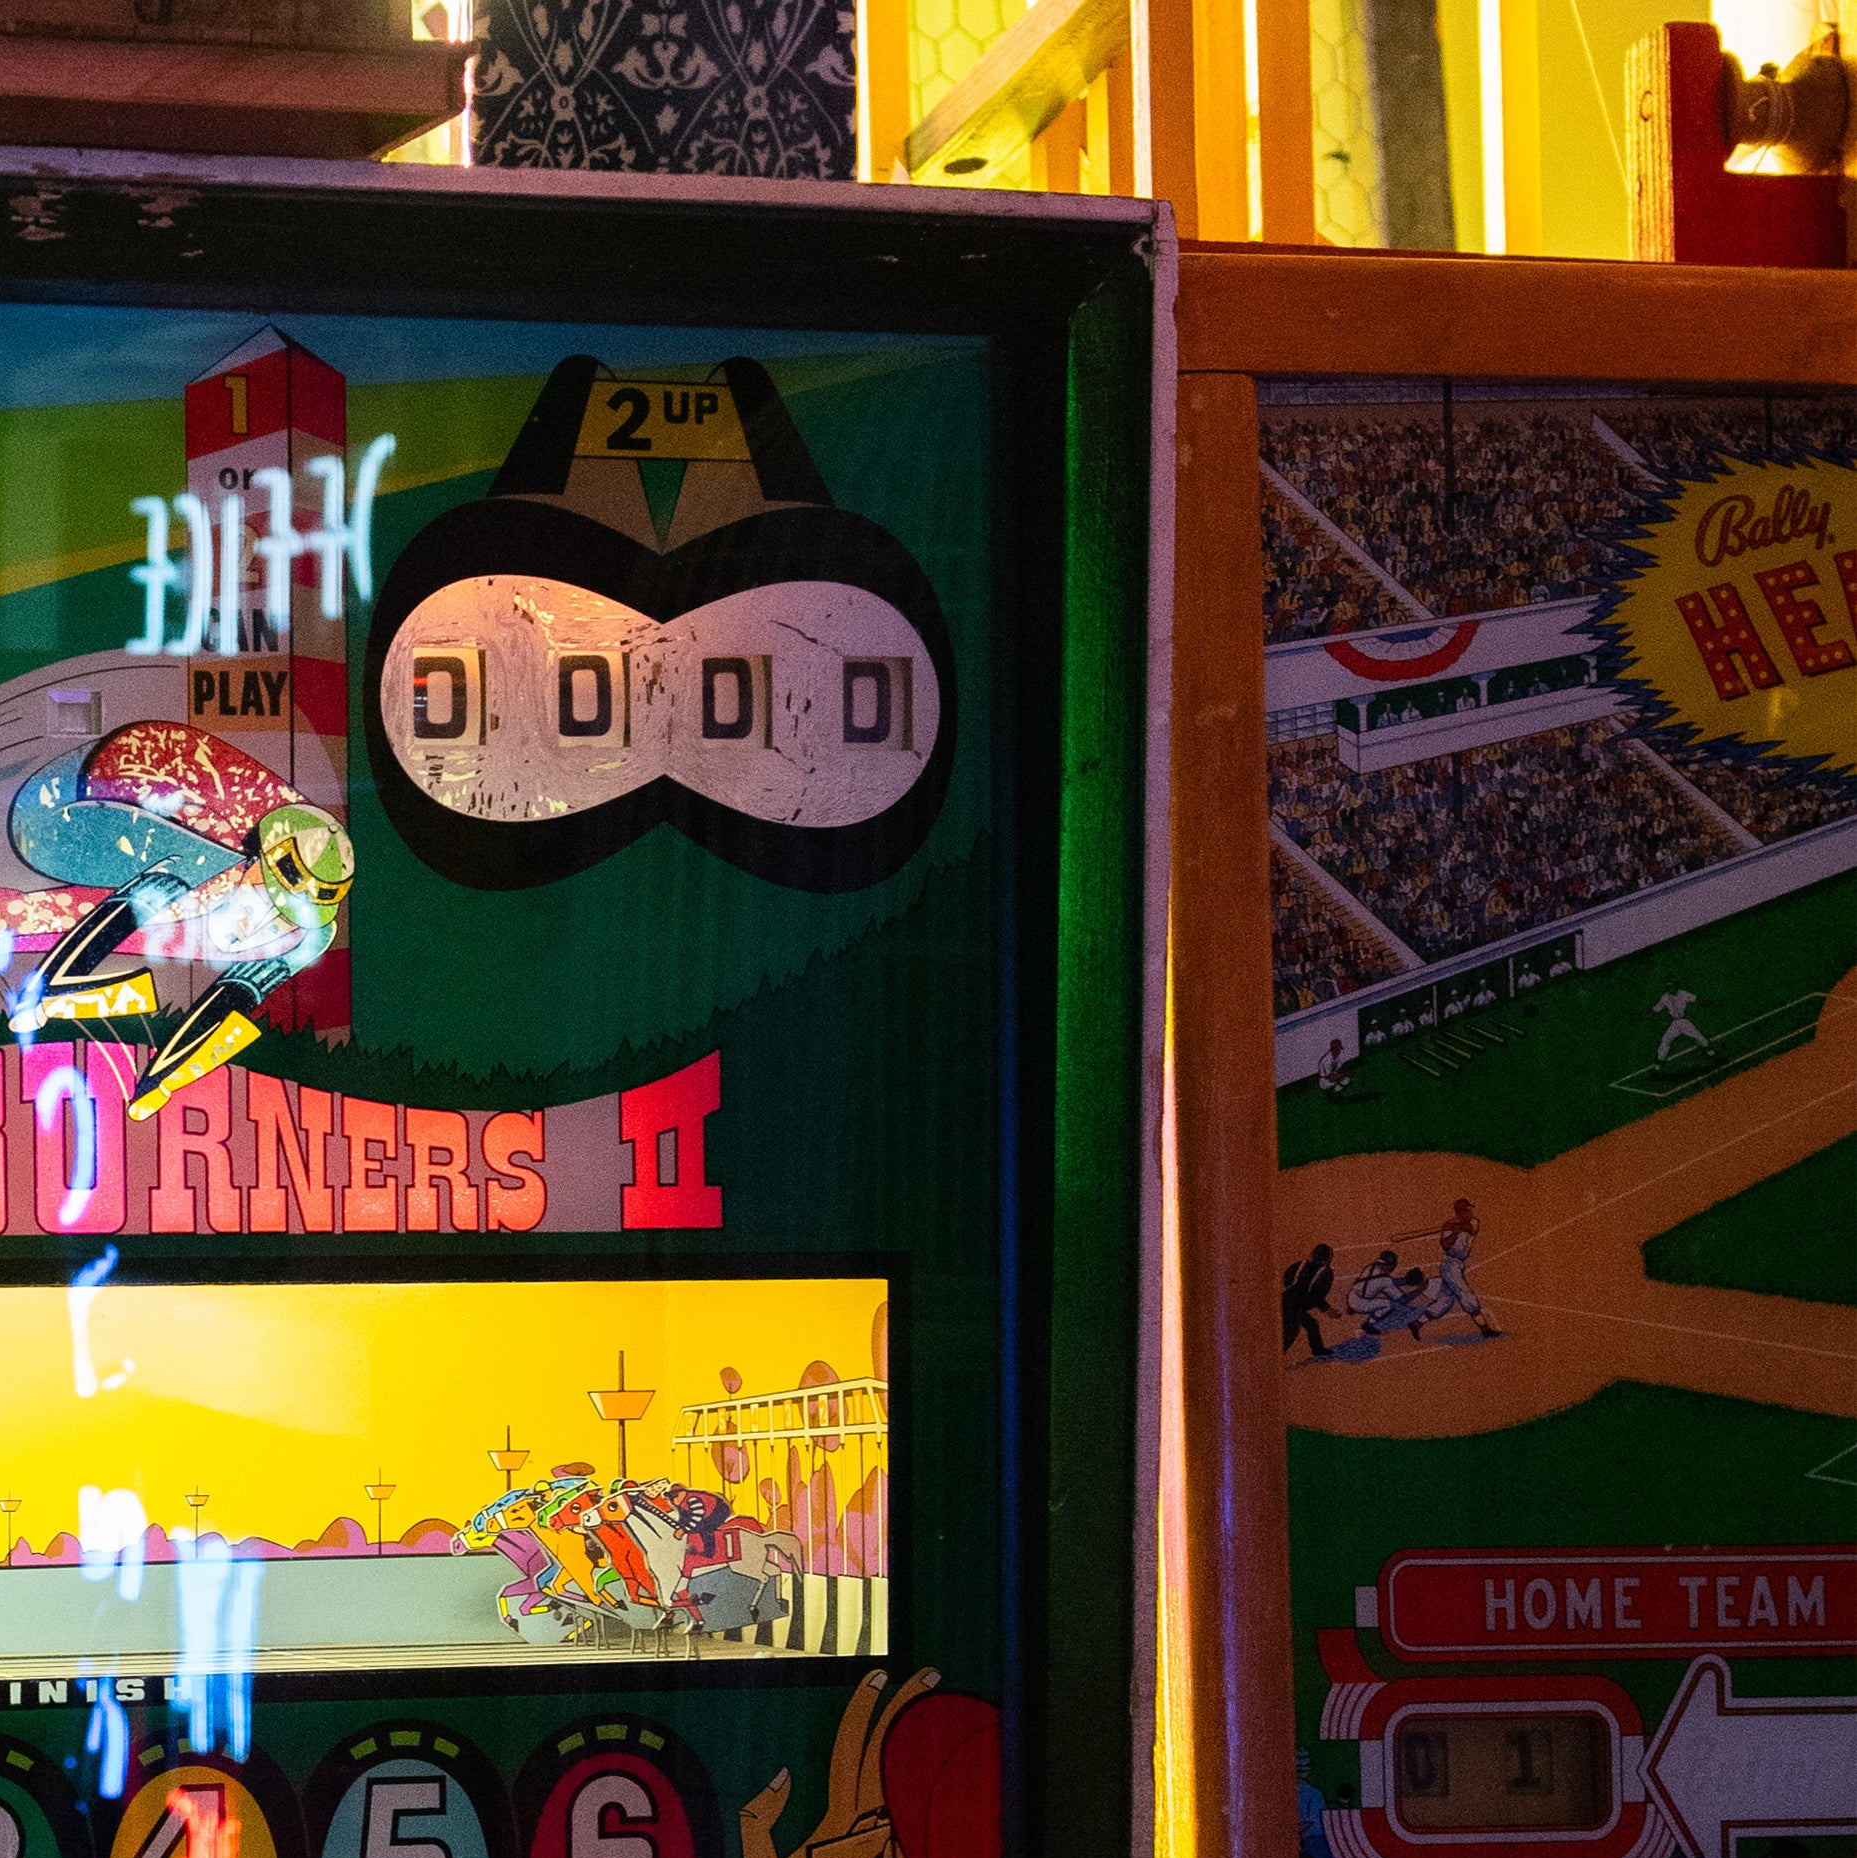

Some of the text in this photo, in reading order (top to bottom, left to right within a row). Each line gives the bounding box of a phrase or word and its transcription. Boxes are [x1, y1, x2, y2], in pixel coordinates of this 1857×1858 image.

[221, 375, 250, 435] 1
[606, 389, 718, 452] 2 UP
[1694, 484, 1831, 568] Bally
[1675, 549, 1857, 702] HE
[193, 670, 288, 716] PLAY
[620, 1051, 724, 1230] II
[1484, 1575, 1827, 1632] HOME TEAM
[1506, 1729, 1537, 1796] 1
